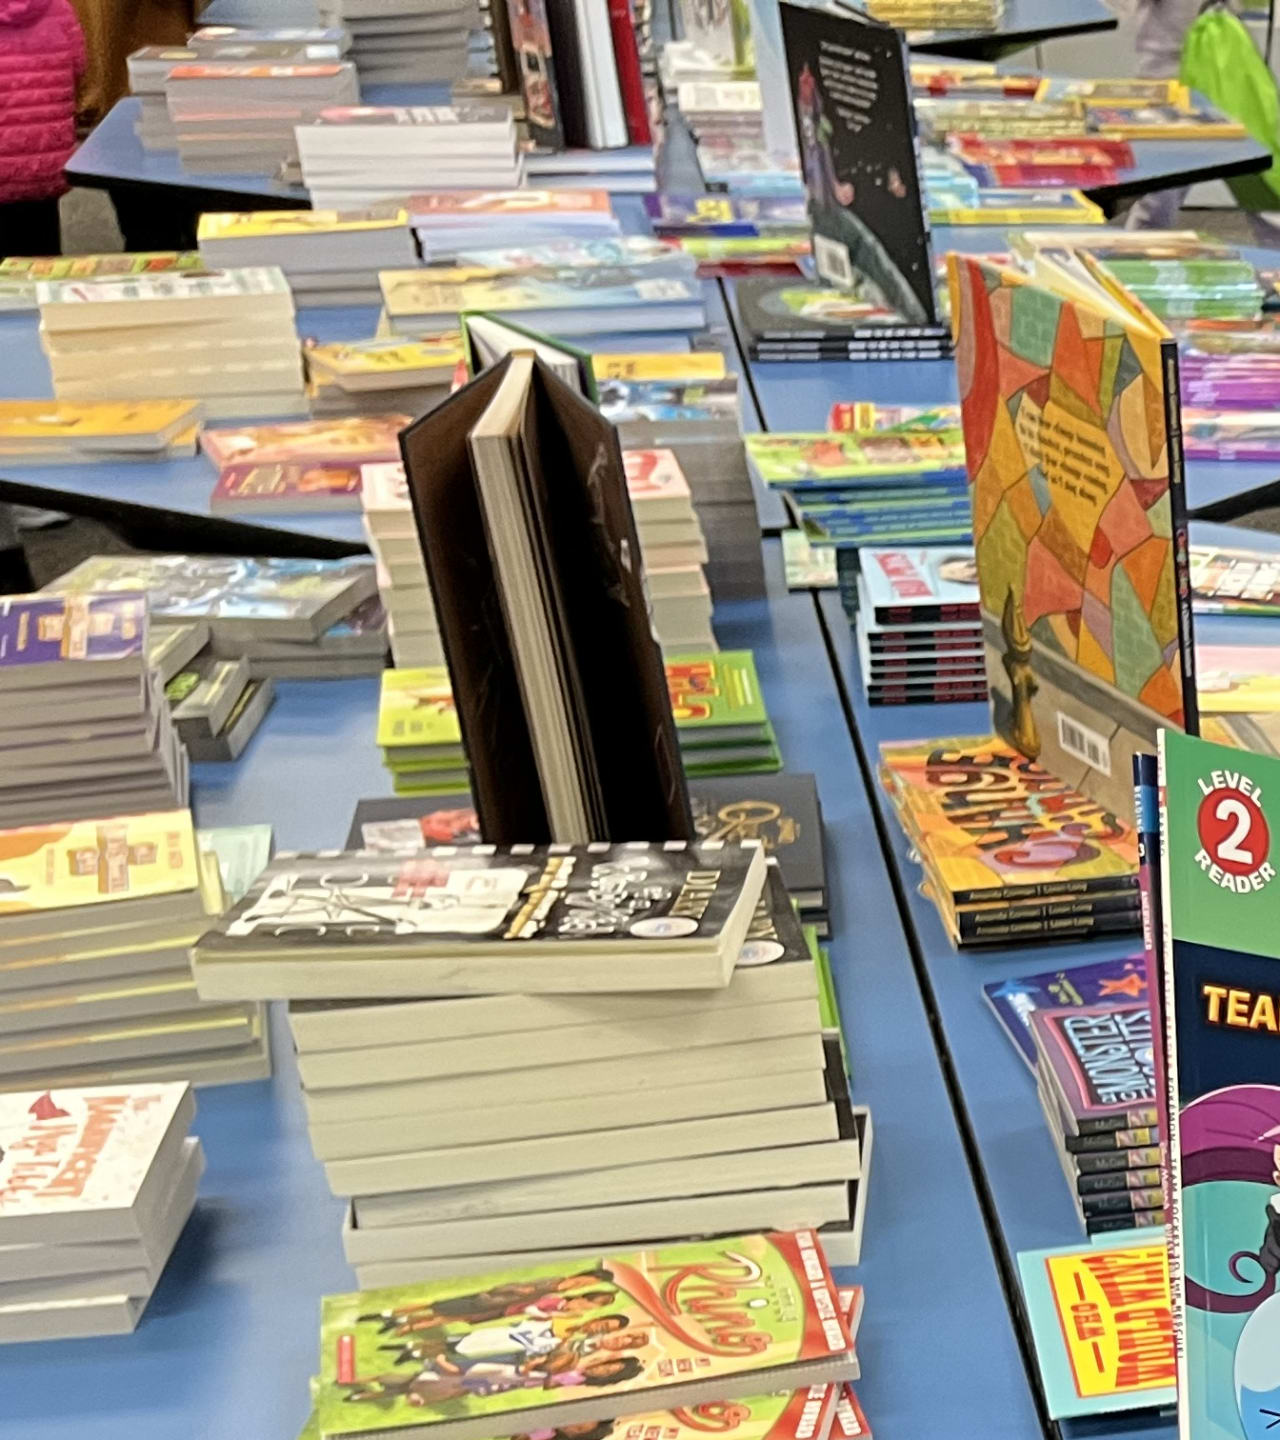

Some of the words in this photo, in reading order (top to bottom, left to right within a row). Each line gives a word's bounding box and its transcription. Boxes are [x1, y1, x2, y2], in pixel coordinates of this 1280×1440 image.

[1197, 769, 1262, 808] LEVEL
[1215, 798, 1253, 865] 2
[1194, 847, 1277, 894] READER
[1064, 1013, 1149, 1096] MONSTER
[664, 1249, 773, 1357] Rhino
[1081, 1252, 1168, 1308] WIN?
[1070, 1303, 1106, 1341] WHO
[1115, 1307, 1178, 1388] WOULD
